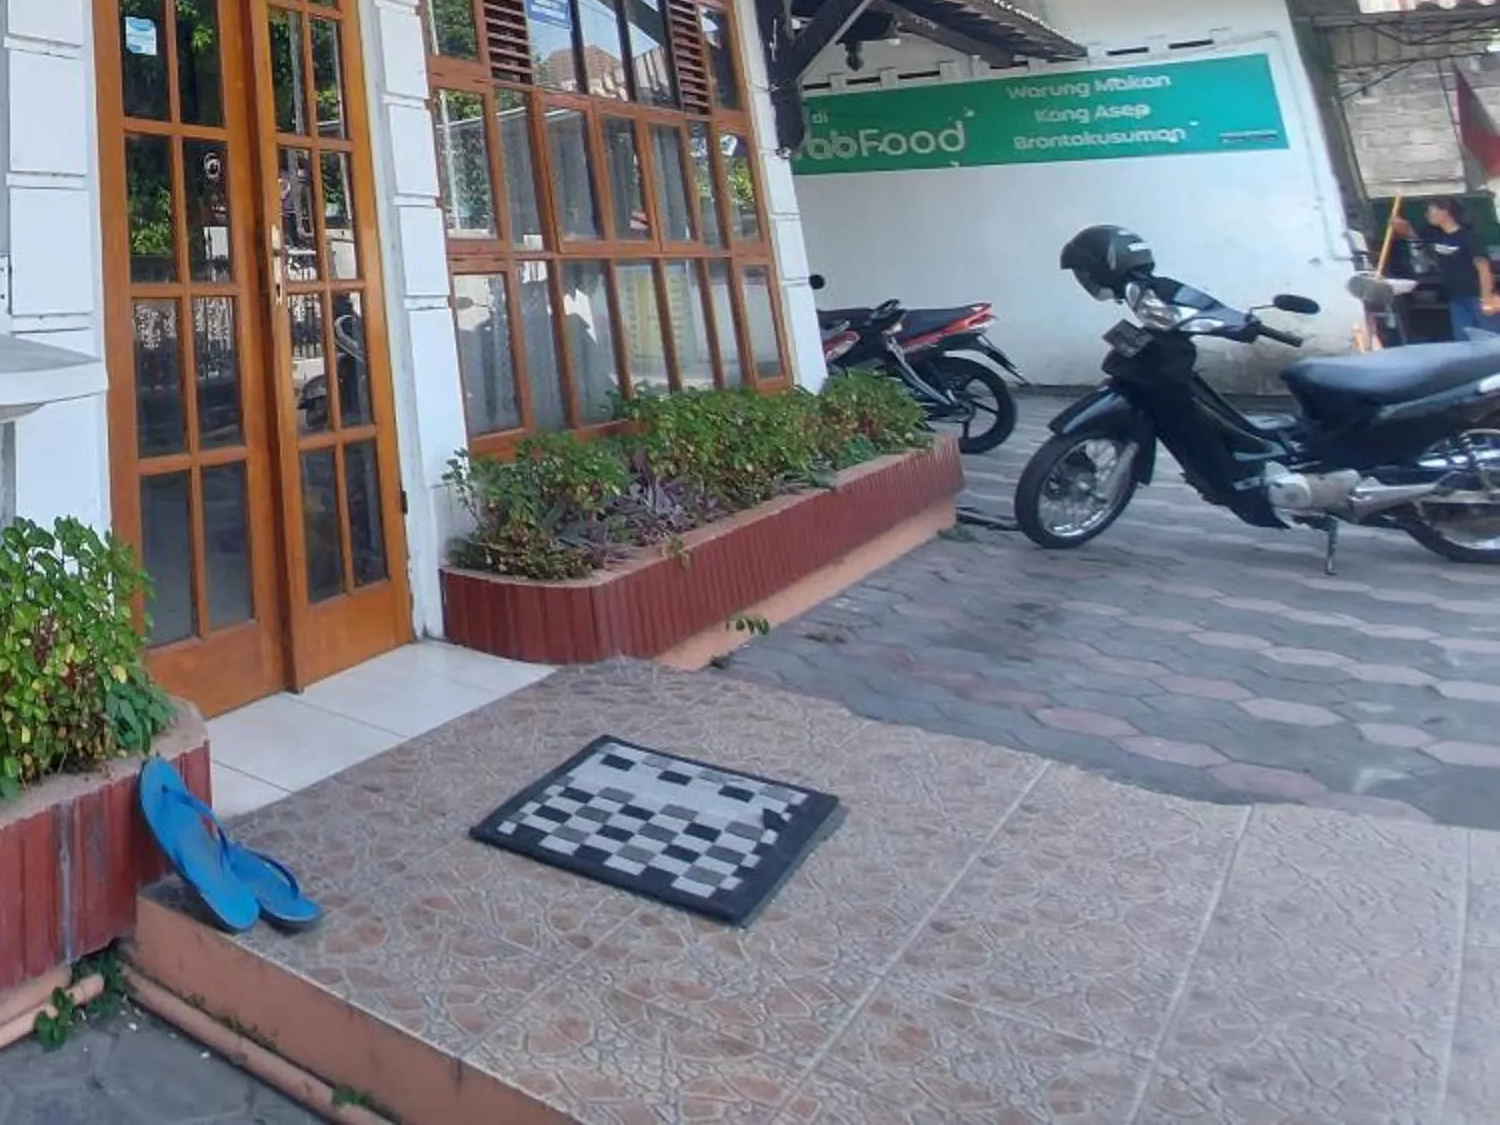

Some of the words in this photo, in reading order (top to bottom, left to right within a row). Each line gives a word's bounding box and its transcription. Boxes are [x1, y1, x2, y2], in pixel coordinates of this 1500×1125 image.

[1006, 81, 1091, 99] Warung
[1094, 75, 1172, 92] Makan
[1034, 106, 1091, 124] Kang
[1094, 103, 1151, 120] Asep
[794, 120, 966, 160] abFood
